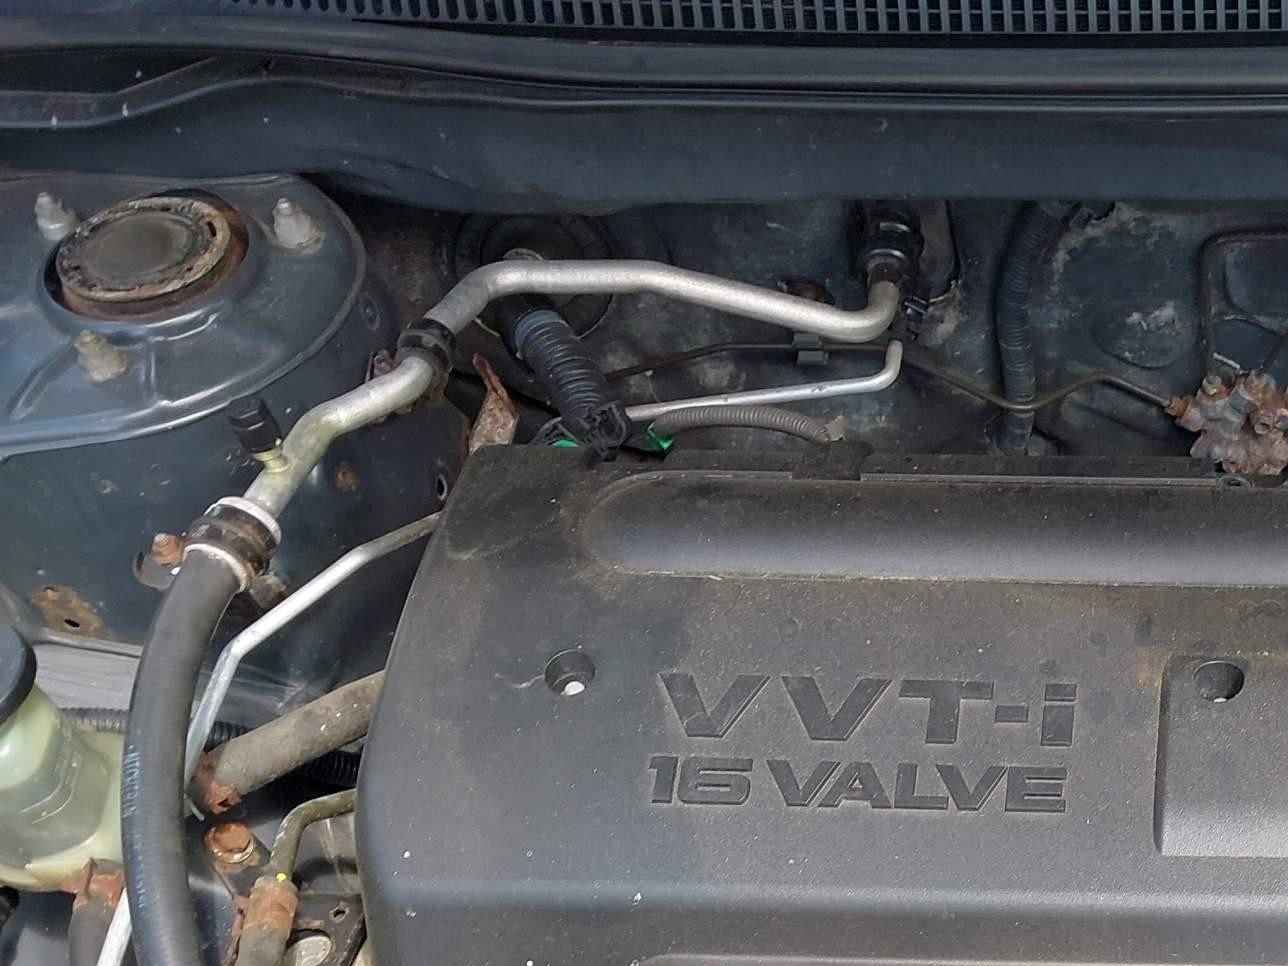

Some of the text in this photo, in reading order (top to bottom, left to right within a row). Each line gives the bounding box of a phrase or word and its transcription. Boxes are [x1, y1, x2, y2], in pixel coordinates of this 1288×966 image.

[658, 672, 1077, 747] VVT-i
[648, 755, 1068, 814] 16 VALVE
